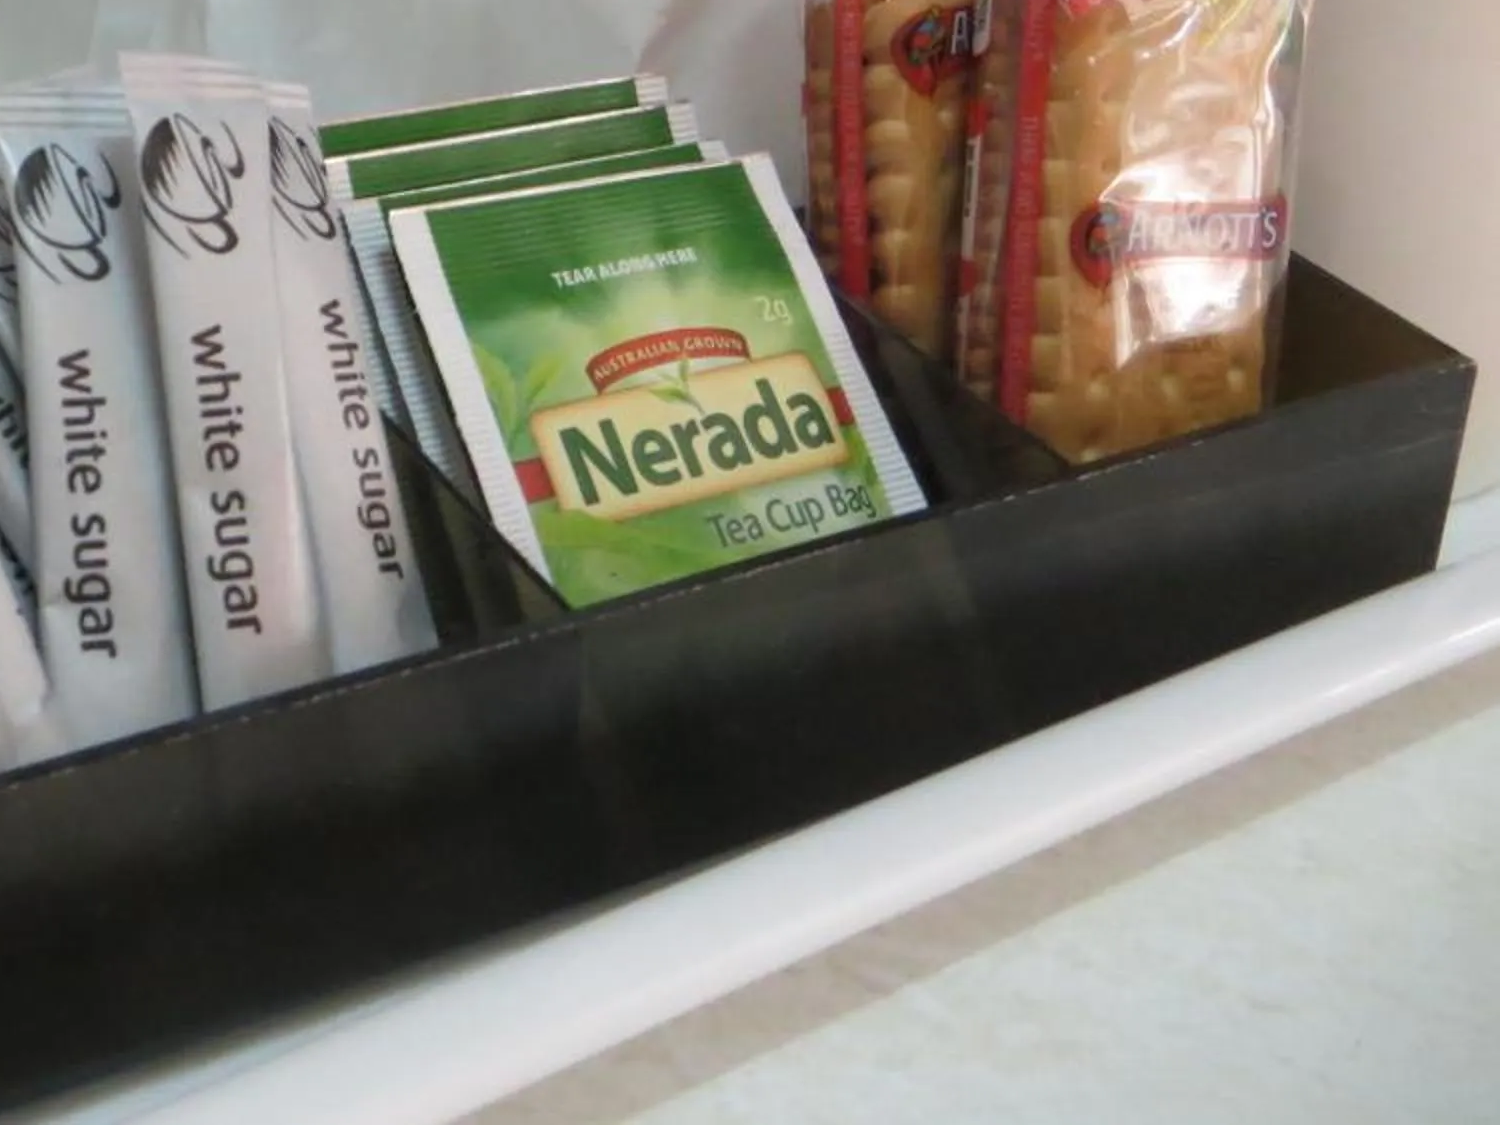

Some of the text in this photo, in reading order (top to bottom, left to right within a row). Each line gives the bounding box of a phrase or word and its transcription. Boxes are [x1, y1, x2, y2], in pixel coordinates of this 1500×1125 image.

[551, 246, 699, 289] TEAR ALONG HERE
[755, 295, 794, 325] 2g
[593, 334, 744, 381] AUSTRALIAN GROWN
[190, 324, 262, 635] white sugar
[318, 297, 404, 581] white sugar
[558, 378, 836, 507] Nerada
[56, 347, 118, 659] white sugar
[705, 483, 878, 549] Tea Cup Bag
